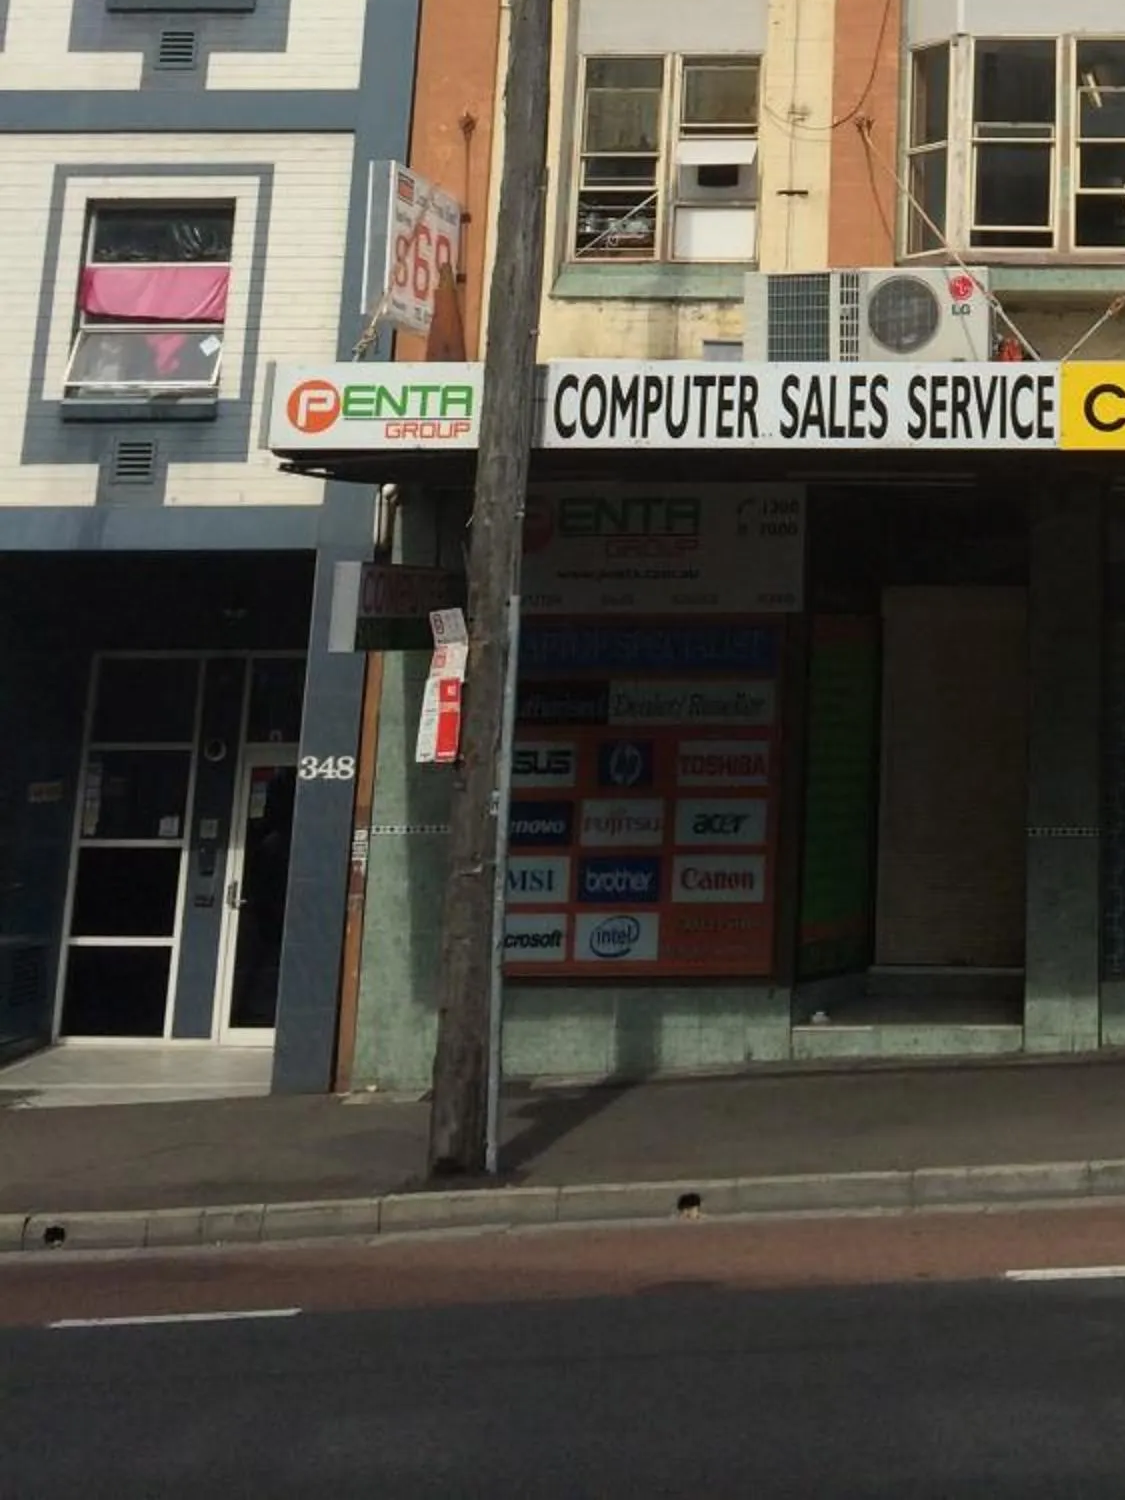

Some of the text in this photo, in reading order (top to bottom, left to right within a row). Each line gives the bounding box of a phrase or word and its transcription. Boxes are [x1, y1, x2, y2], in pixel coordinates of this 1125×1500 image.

[289, 383, 473, 430] PENTA
[553, 373, 1056, 440] COMPUTER SALES SERVICE
[384, 422, 471, 439] GROUP
[299, 755, 355, 780] 348
[512, 750, 572, 776] SUS
[679, 753, 766, 776] TOSHIBA
[692, 813, 752, 835] acer
[584, 866, 655, 894] brother
[681, 866, 755, 891] Canon
[503, 929, 562, 949] crosoft
[596, 925, 634, 947] intel
